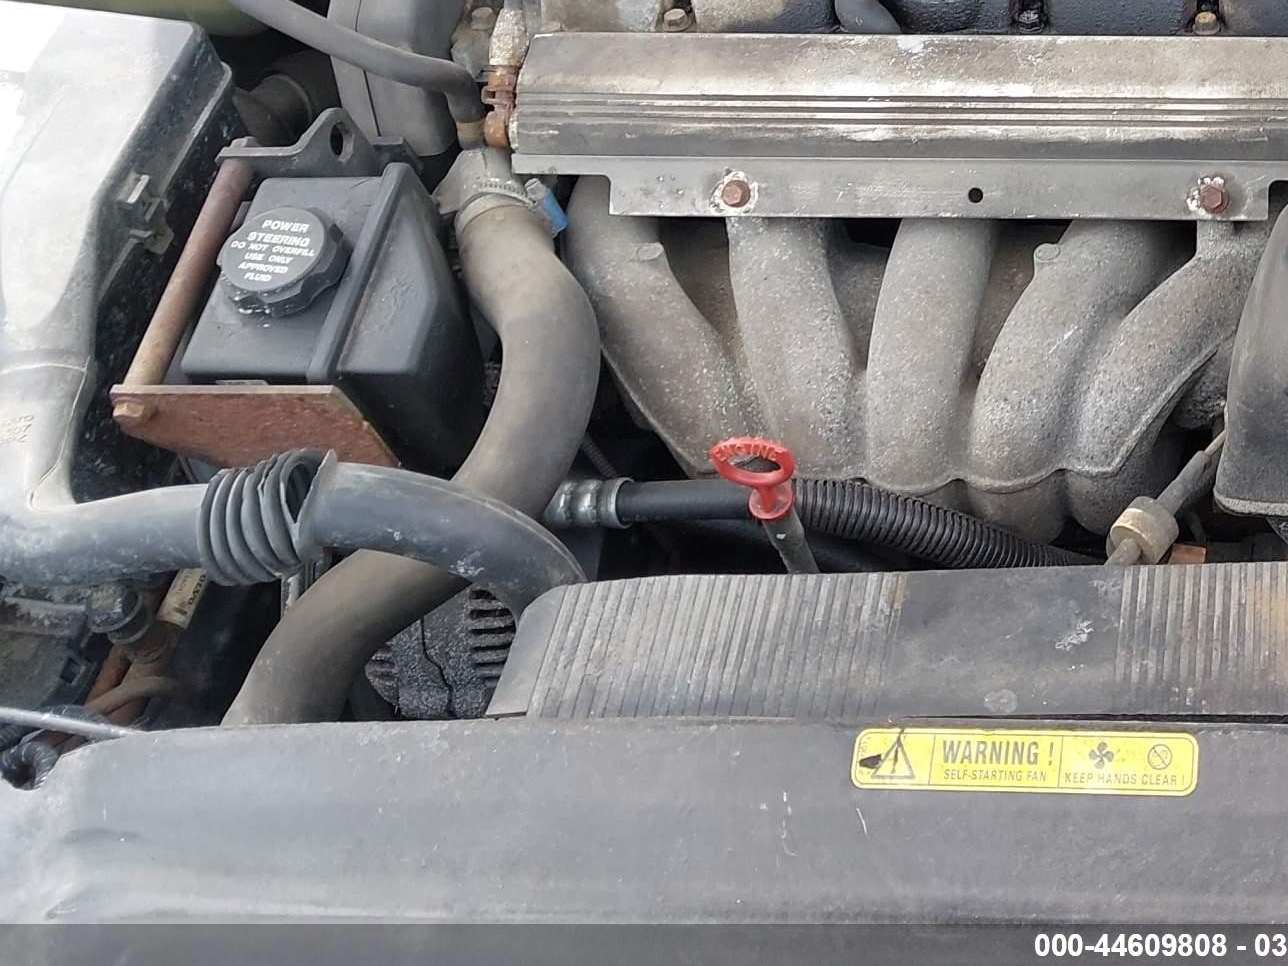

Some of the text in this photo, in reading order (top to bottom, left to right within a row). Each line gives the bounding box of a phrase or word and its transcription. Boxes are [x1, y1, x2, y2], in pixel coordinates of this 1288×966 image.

[262, 220, 310, 233] POWER
[247, 231, 311, 246] STEERING
[231, 240, 316, 257] DO NOT OVERFILL
[244, 253, 294, 265] USE ONLY
[238, 262, 289, 274] APPROVED
[243, 273, 272, 282] FLUID
[713, 442, 777, 462] ENGINE
[942, 739, 1055, 766] WARNING !
[943, 768, 1048, 783] SELF-STARTING FAN
[1064, 771, 1094, 785] KEEP
[1097, 772, 1137, 786] HANDS
[1140, 773, 1178, 786] CLEAR
